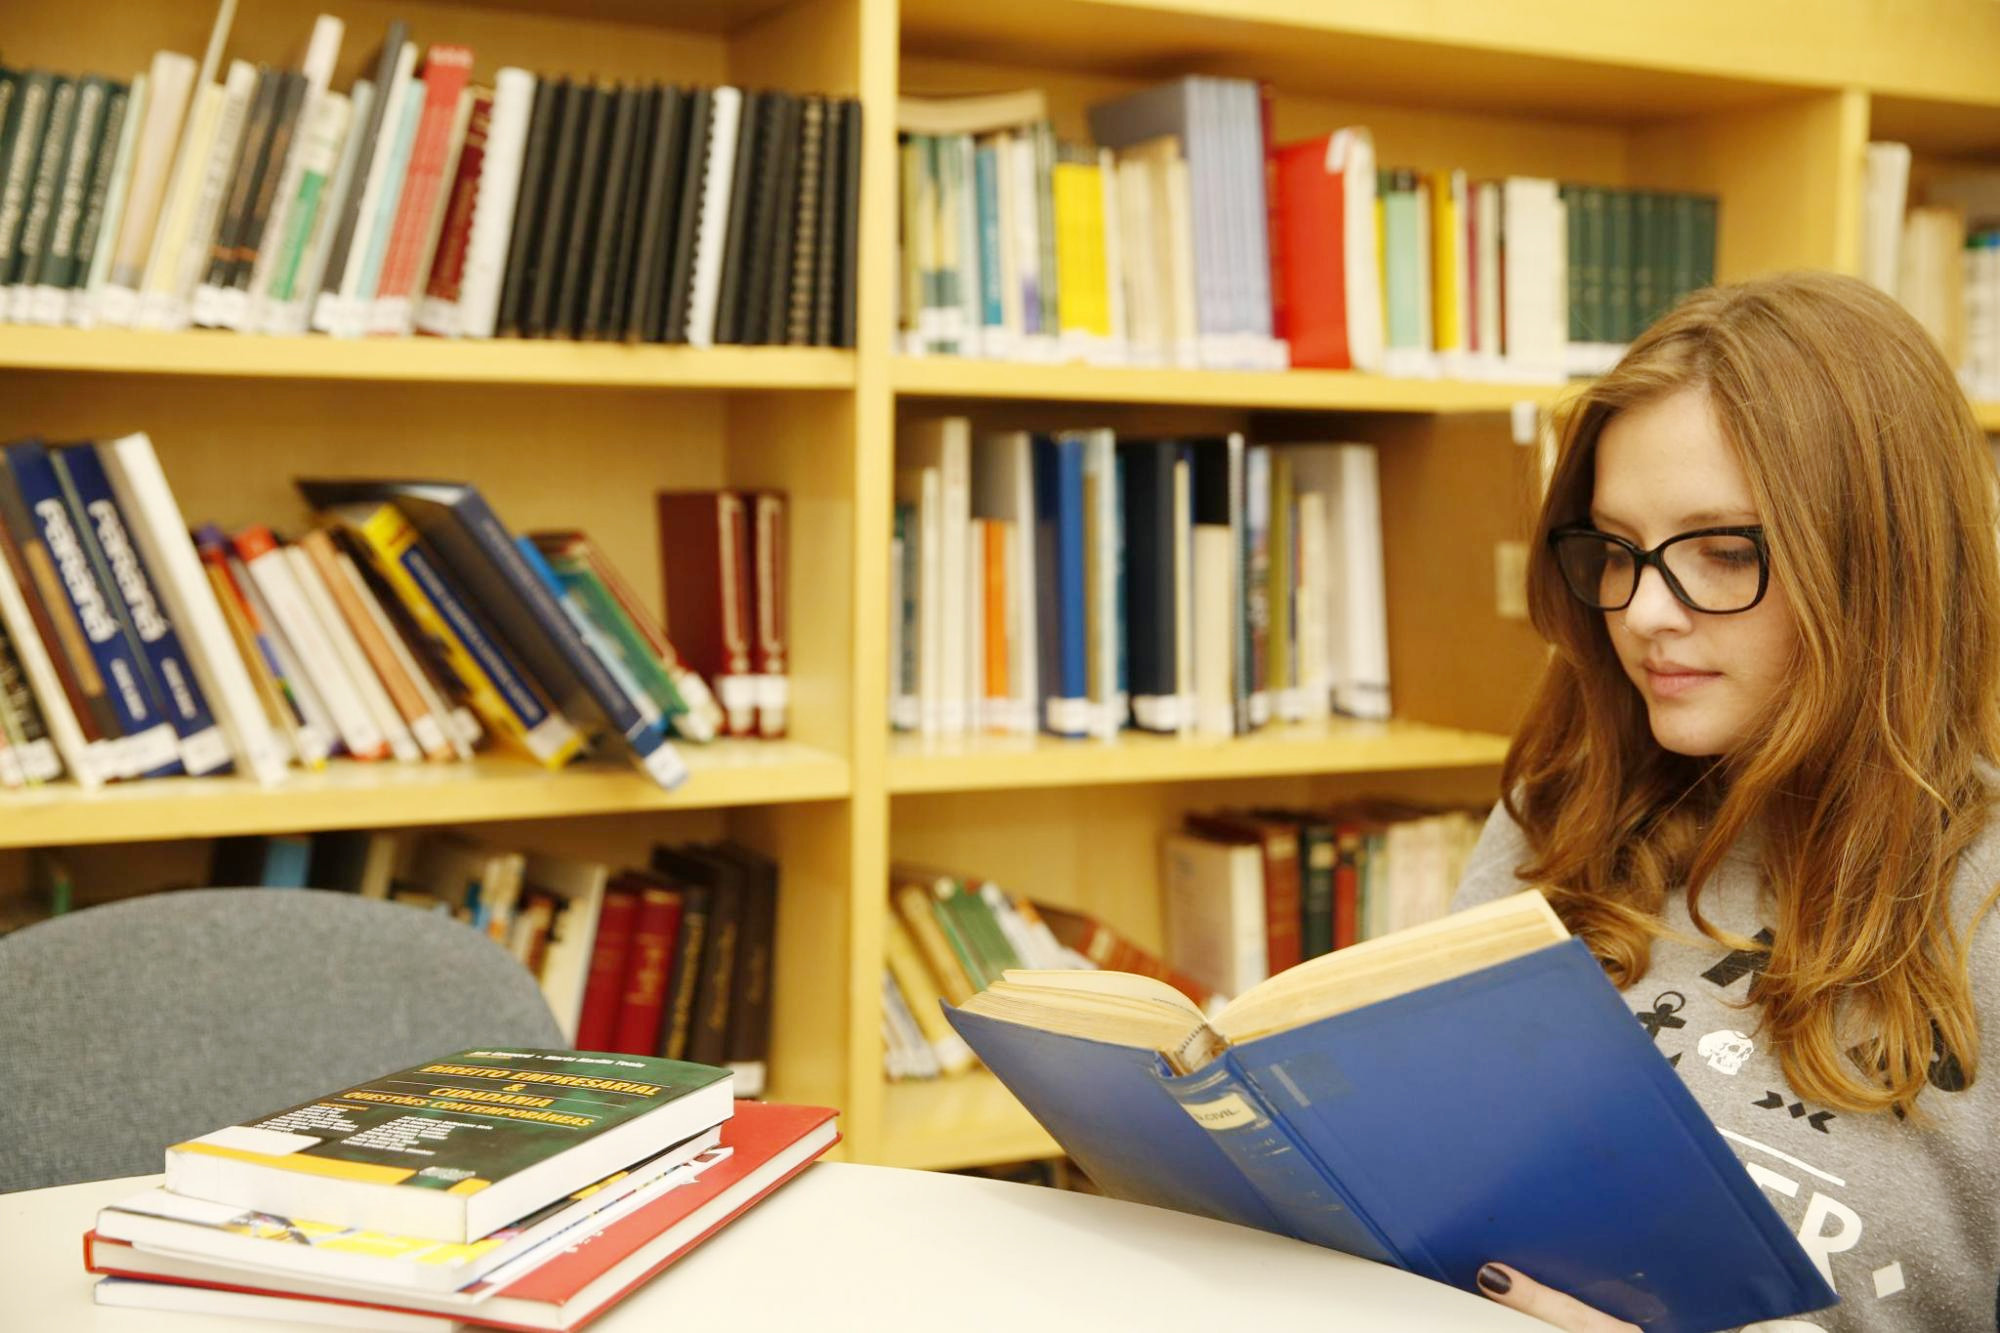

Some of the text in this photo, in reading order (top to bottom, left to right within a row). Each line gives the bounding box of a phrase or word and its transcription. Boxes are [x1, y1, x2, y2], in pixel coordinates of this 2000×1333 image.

[420, 1063, 662, 1096] DIREITO EMPRESARIAL
[502, 1083, 525, 1093] &
[342, 1091, 595, 1127] QUESTÕES CONTEMPORÂNEAS
[429, 1087, 555, 1108] CIDADANIA
